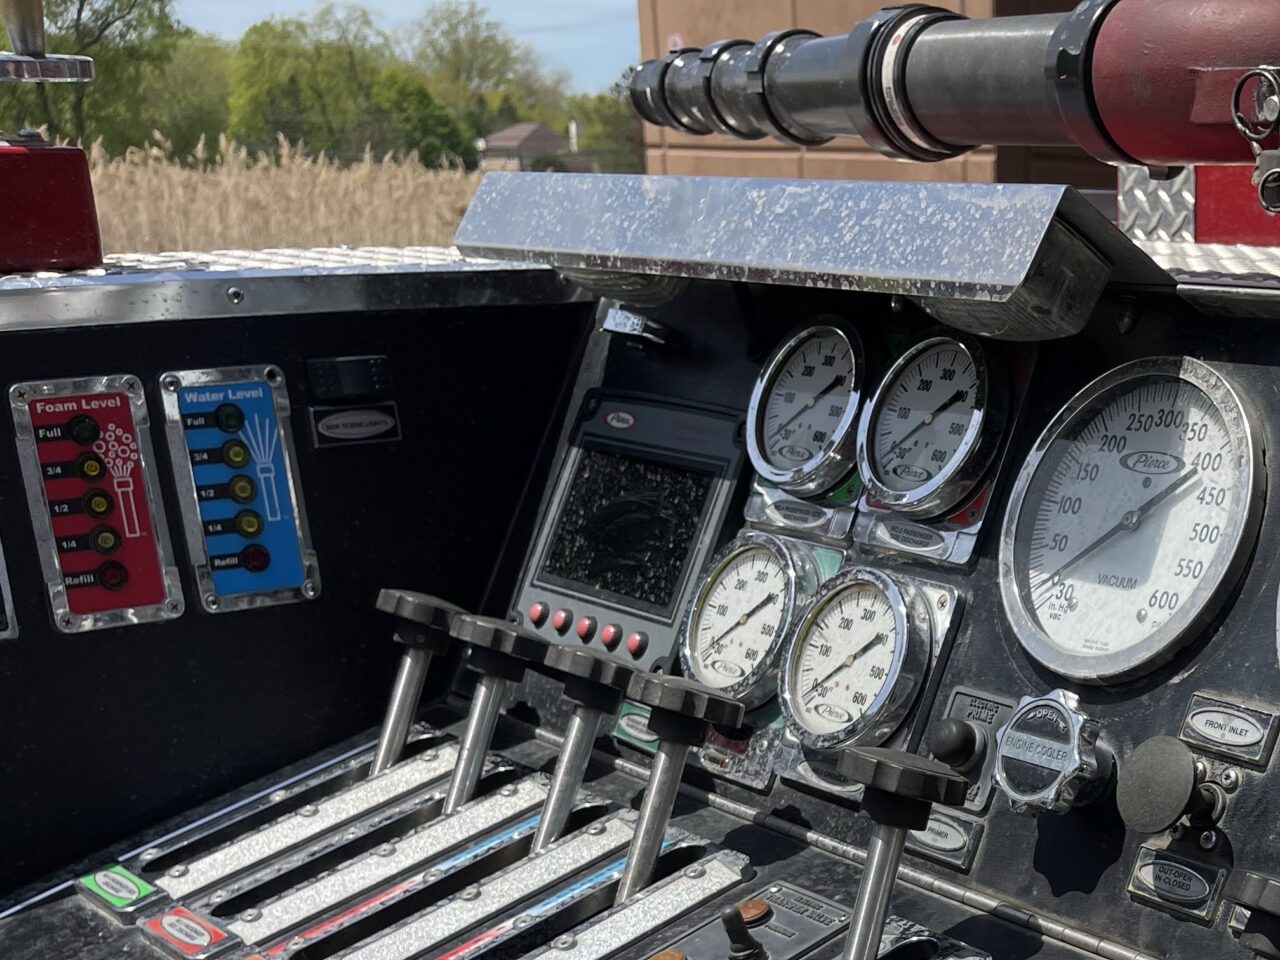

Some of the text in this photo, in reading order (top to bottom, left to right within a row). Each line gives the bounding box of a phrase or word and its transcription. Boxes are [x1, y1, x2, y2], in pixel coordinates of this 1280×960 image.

[185, 387, 263, 403] Water Level
[36, 396, 121, 413] Foam Level
[186, 416, 205, 426] Full
[1126, 414, 1154, 432] 250
[1154, 409, 1183, 428] 300
[38, 427, 62, 439] Full
[1181, 423, 1208, 441] 350
[1100, 435, 1126, 453] 200
[1135, 454, 1170, 470] Pierce
[1192, 453, 1223, 472] 400
[46, 465, 62, 476] 3/4
[1077, 463, 1099, 481] 150
[1057, 496, 1081, 514] 100
[1196, 488, 1226, 507] 450
[53, 503, 69, 513] 1/2
[1189, 523, 1220, 544] 500
[61, 539, 77, 549] 1/4
[1050, 533, 1068, 552] 50
[214, 556, 239, 567] Refill
[1174, 558, 1203, 579] 550
[65, 573, 94, 585] Refill
[755, 571, 768, 584] 300
[1098, 574, 1138, 589] VACUUM
[1148, 590, 1179, 610] 600
[717, 605, 728, 617] 100
[860, 609, 876, 622] 300
[760, 625, 774, 637] 500
[839, 617, 853, 631] 200
[744, 648, 758, 661] 600
[818, 644, 832, 657] 100
[869, 666, 885, 680] 500
[853, 692, 867, 705] 600
[1036, 709, 1058, 723] OPEN
[1204, 719, 1249, 737] FRONT INLET
[1005, 736, 1067, 759] ENGINE COOLER
[927, 825, 950, 841] PRIMER
[1154, 873, 1191, 891] IN-CLOSED
[1159, 865, 1193, 883] OUT-OPEN
